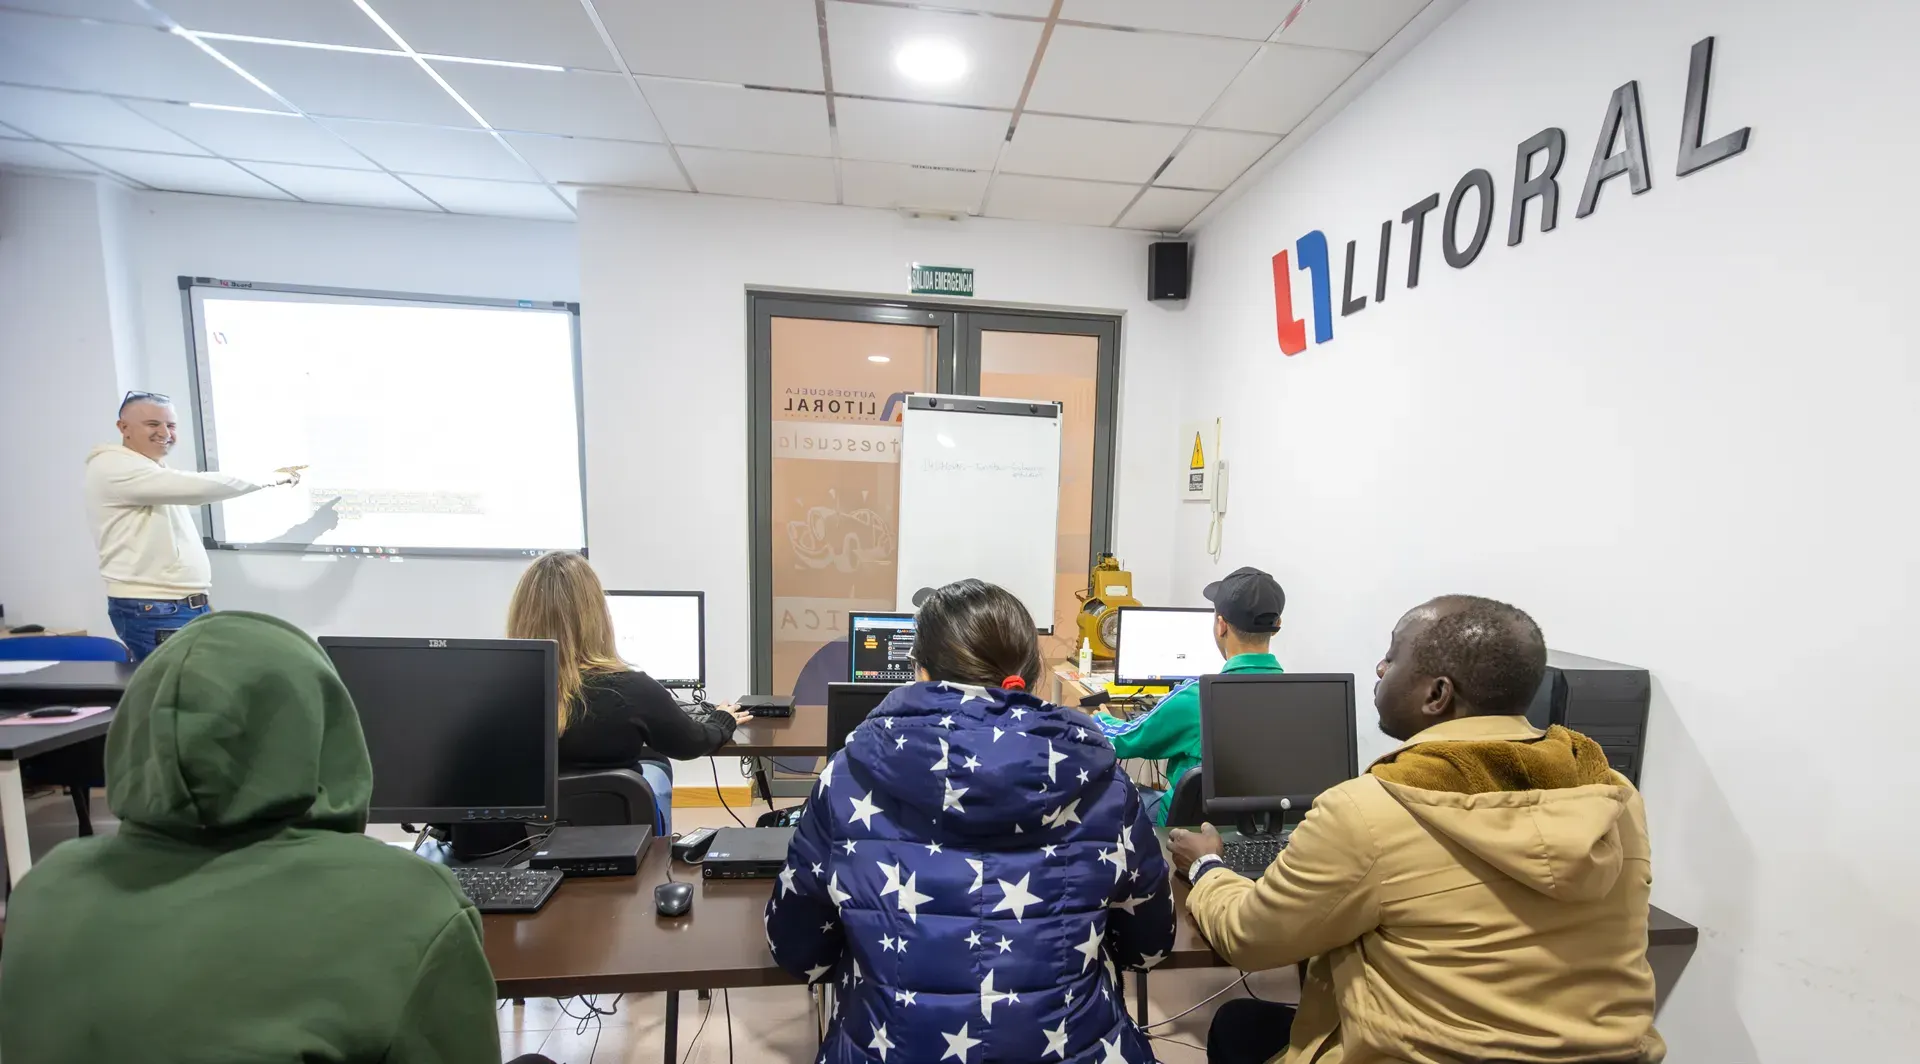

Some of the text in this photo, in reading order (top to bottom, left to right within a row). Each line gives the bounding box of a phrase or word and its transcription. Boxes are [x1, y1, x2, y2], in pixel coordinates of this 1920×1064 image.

[1341, 36, 1752, 317] LITORAL
[911, 269, 973, 292] SALIDA EMERGENCIA
[428, 639, 447, 648] IBM
